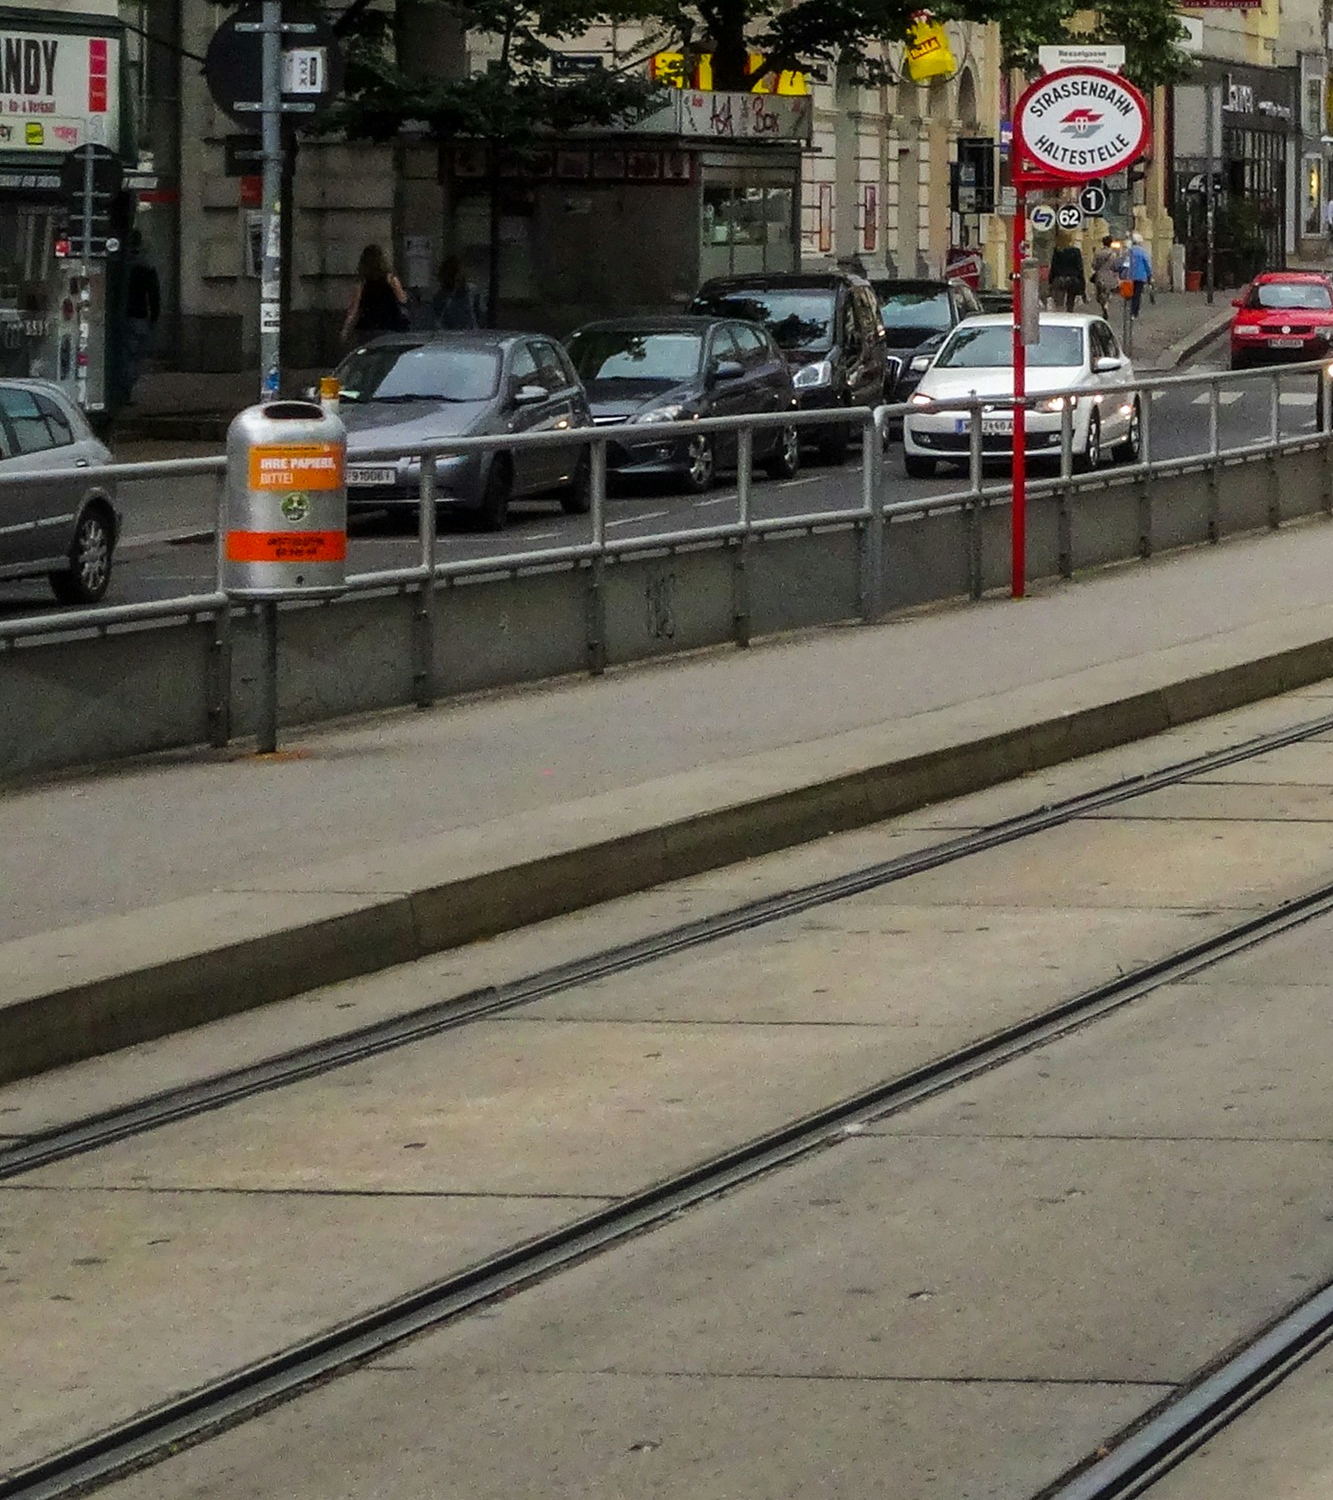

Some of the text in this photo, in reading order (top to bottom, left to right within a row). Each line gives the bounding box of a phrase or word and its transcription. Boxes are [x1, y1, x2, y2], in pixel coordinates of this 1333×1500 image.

[1030, 81, 1134, 118] STRASSENBAHN
[1034, 134, 1130, 165] HALTESTELLE
[1086, 191, 1096, 209] 1
[1059, 210, 1079, 225] 62
[260, 458, 287, 469] IHRE
